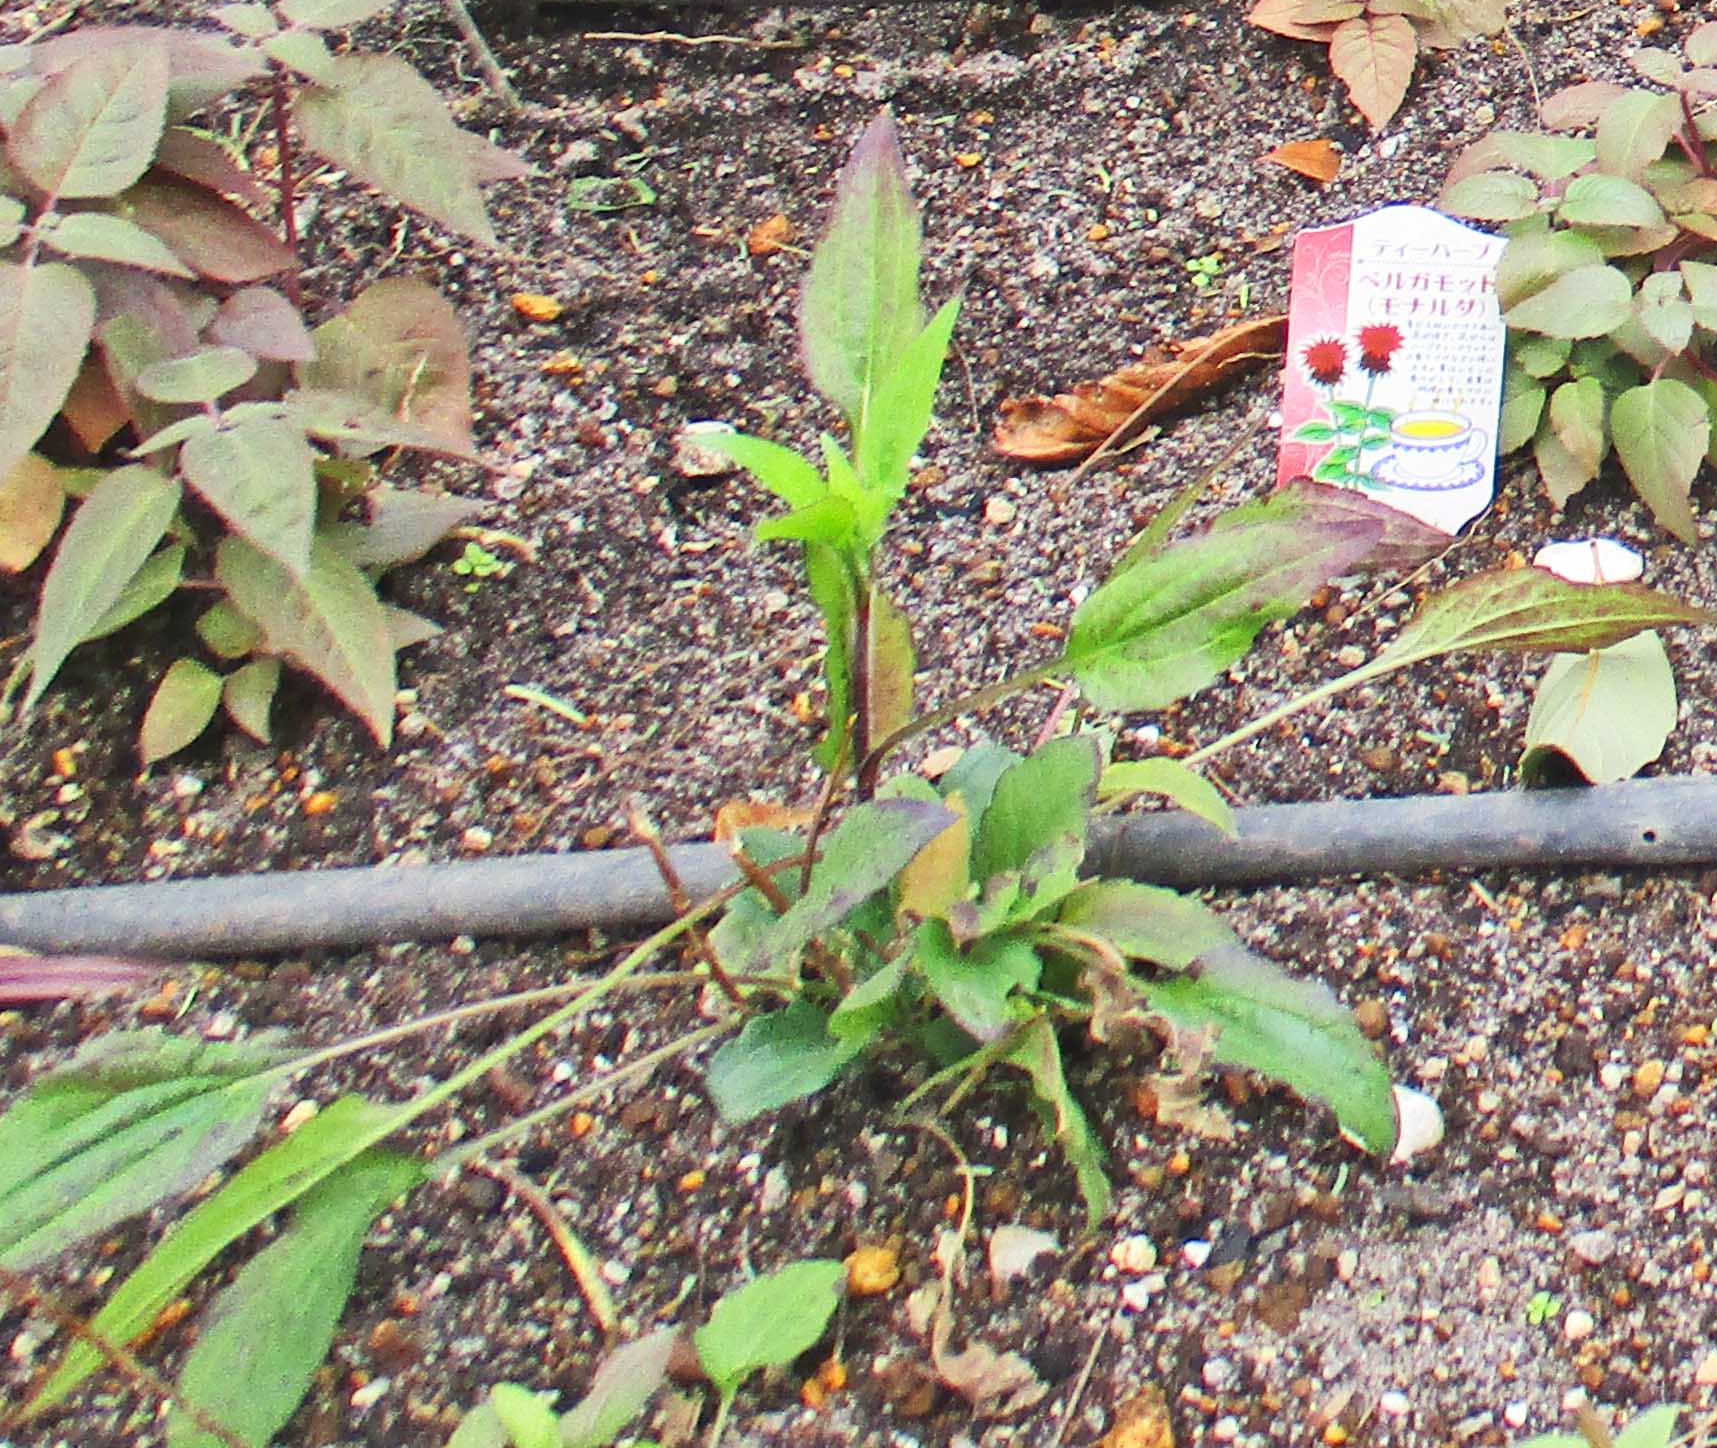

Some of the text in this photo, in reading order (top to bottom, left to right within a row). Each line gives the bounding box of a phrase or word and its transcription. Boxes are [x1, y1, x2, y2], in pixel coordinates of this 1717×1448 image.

[1359, 271, 1496, 294] ベルガモット
